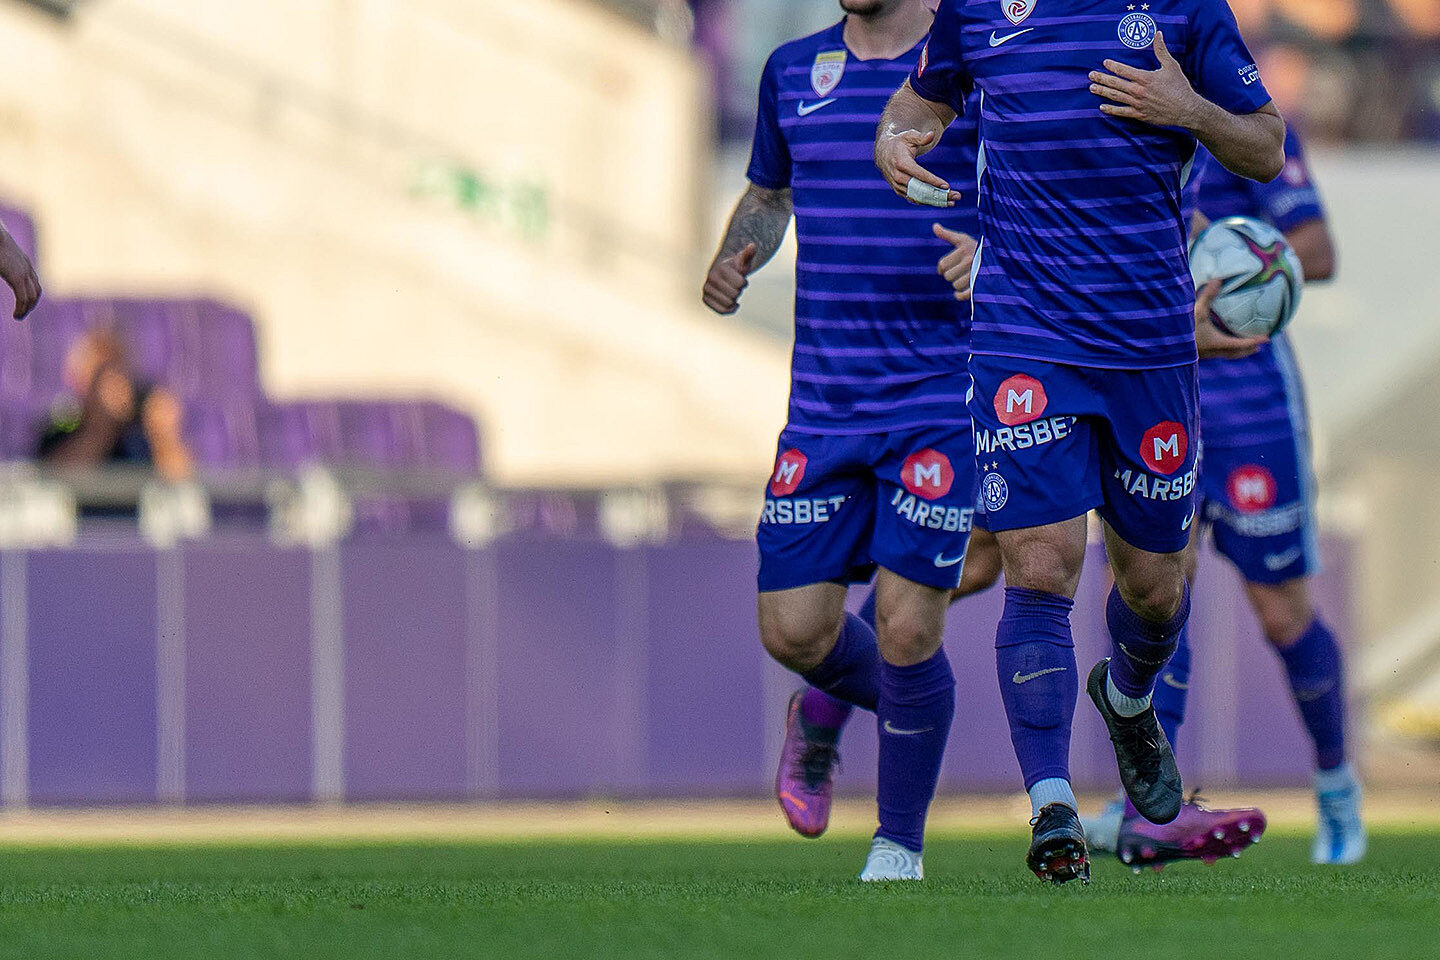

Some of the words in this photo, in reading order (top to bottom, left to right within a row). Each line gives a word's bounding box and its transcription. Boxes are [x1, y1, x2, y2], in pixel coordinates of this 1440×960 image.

[1006, 389, 1033, 414] M
[1153, 433, 1179, 461] M
[774, 460, 800, 485] M
[913, 462, 942, 487] M
